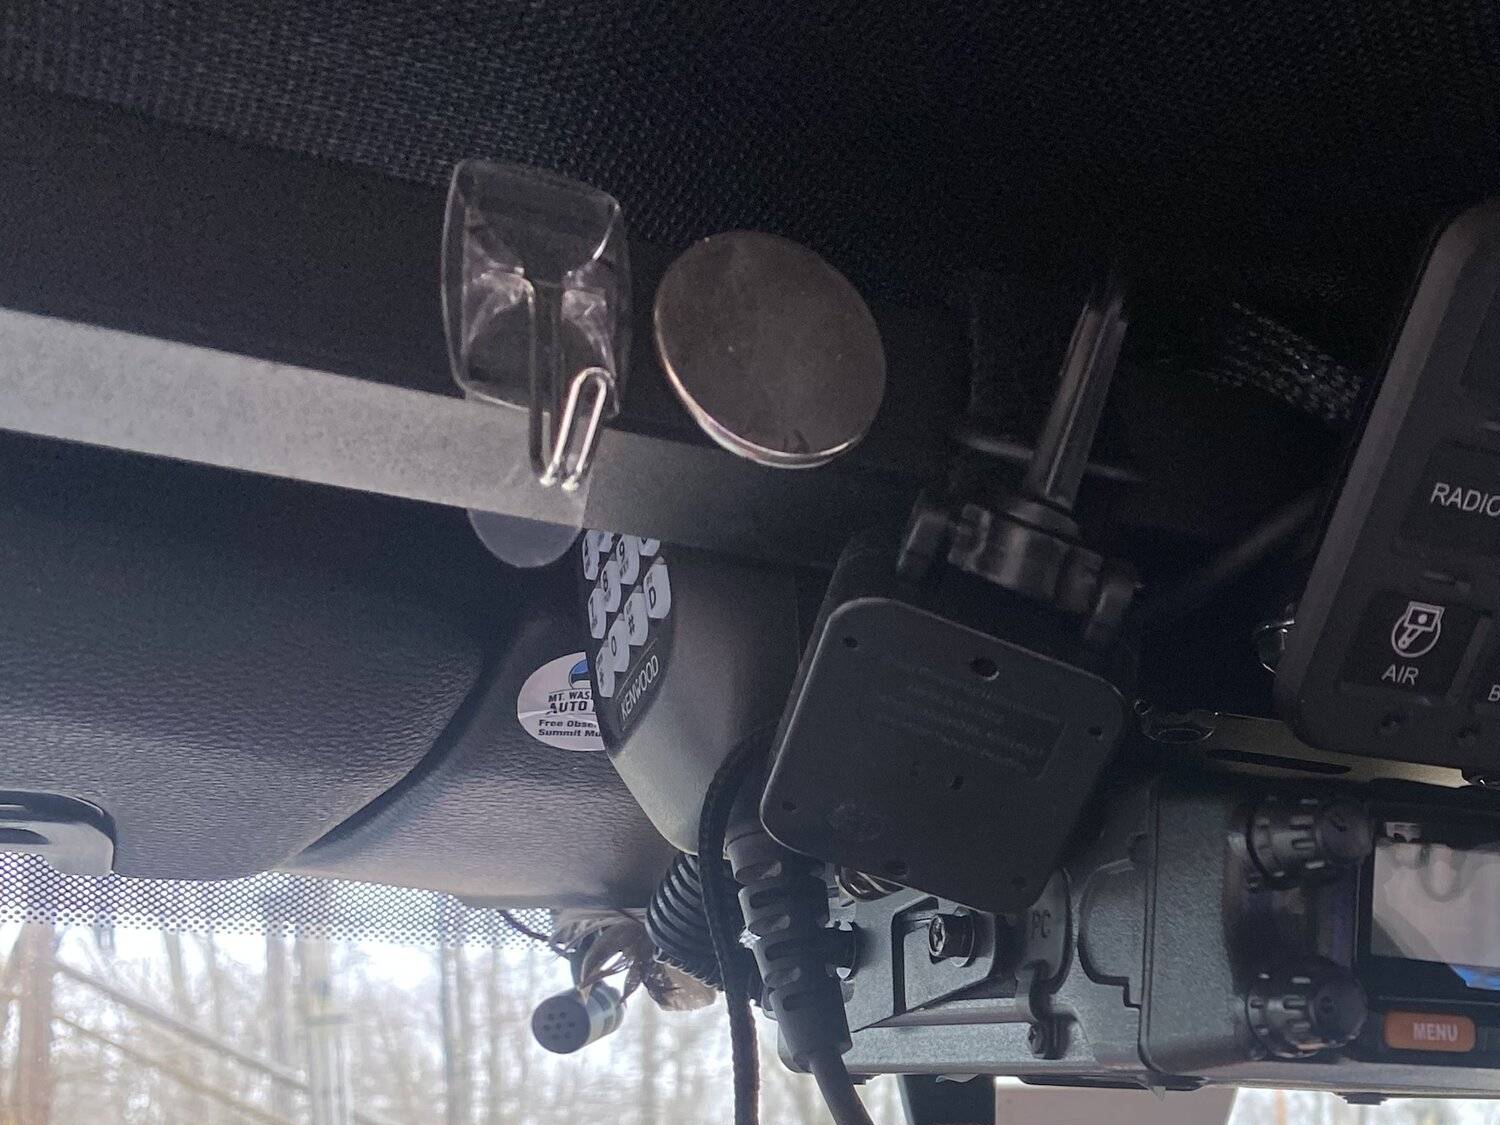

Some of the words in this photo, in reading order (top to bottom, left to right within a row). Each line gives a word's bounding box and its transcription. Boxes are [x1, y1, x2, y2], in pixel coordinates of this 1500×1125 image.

[1381, 663, 1419, 686] AIR
[620, 654, 660, 721] KENWOOD
[568, 690, 593, 701] WAS
[545, 700, 587, 715] AUTO
[538, 719, 563, 727] Free
[538, 729, 582, 737] Summit
[1412, 1022, 1459, 1043] MENU
